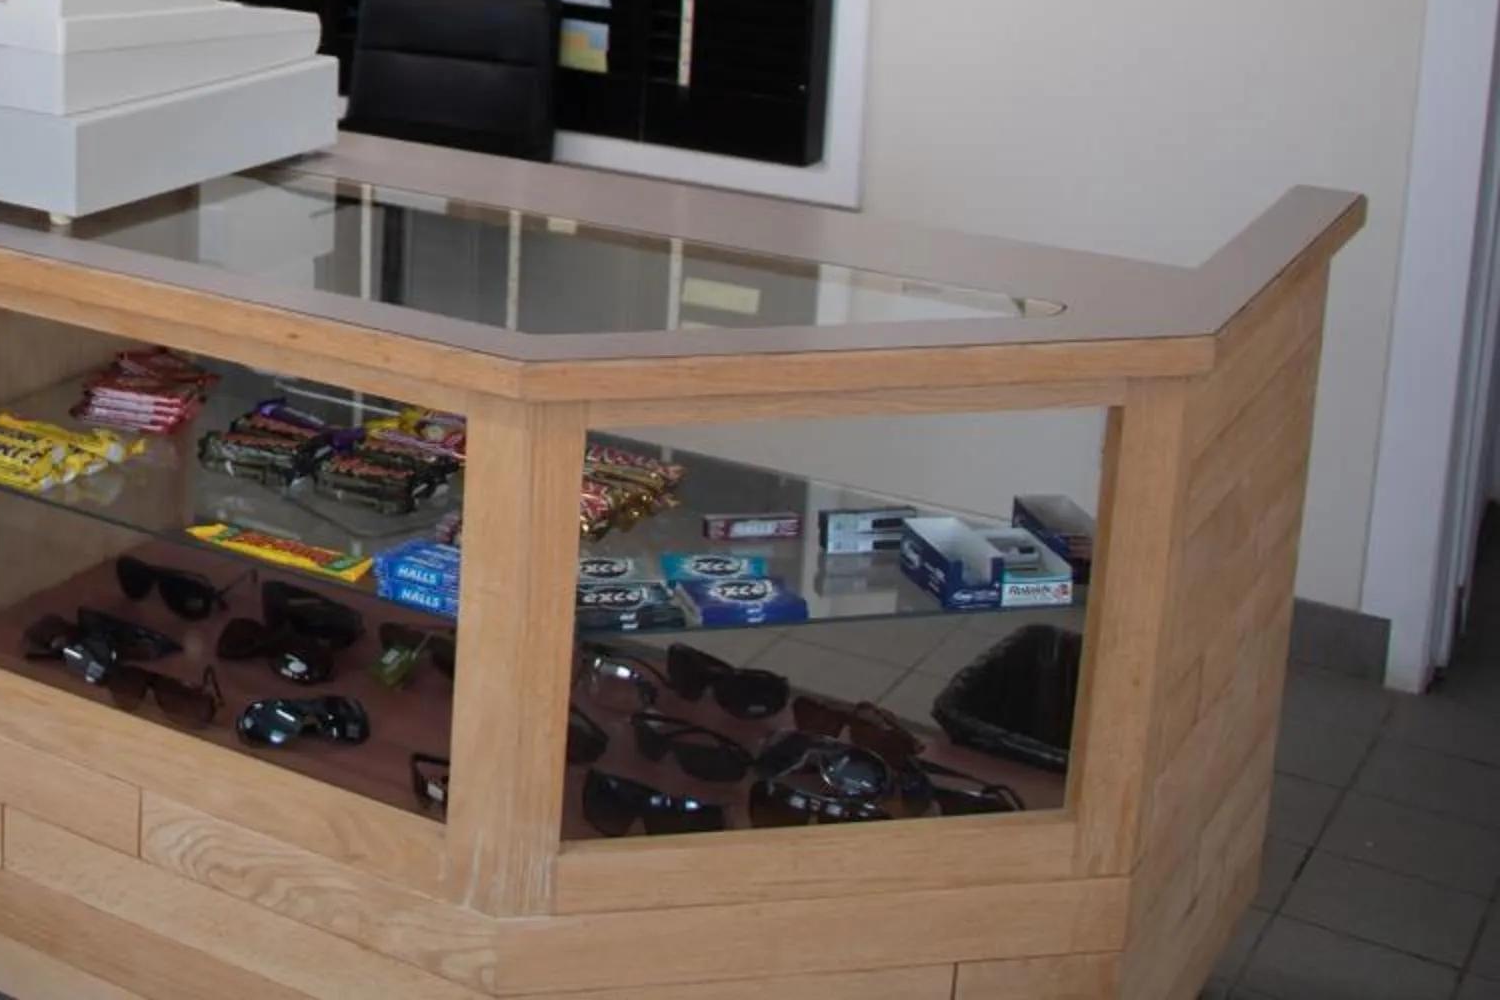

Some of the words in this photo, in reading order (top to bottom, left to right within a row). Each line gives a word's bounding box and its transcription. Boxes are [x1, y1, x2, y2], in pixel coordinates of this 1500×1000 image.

[398, 566, 437, 585] HALLS
[582, 586, 649, 604] excel
[709, 579, 774, 598] excel
[401, 589, 440, 608] HALLS
